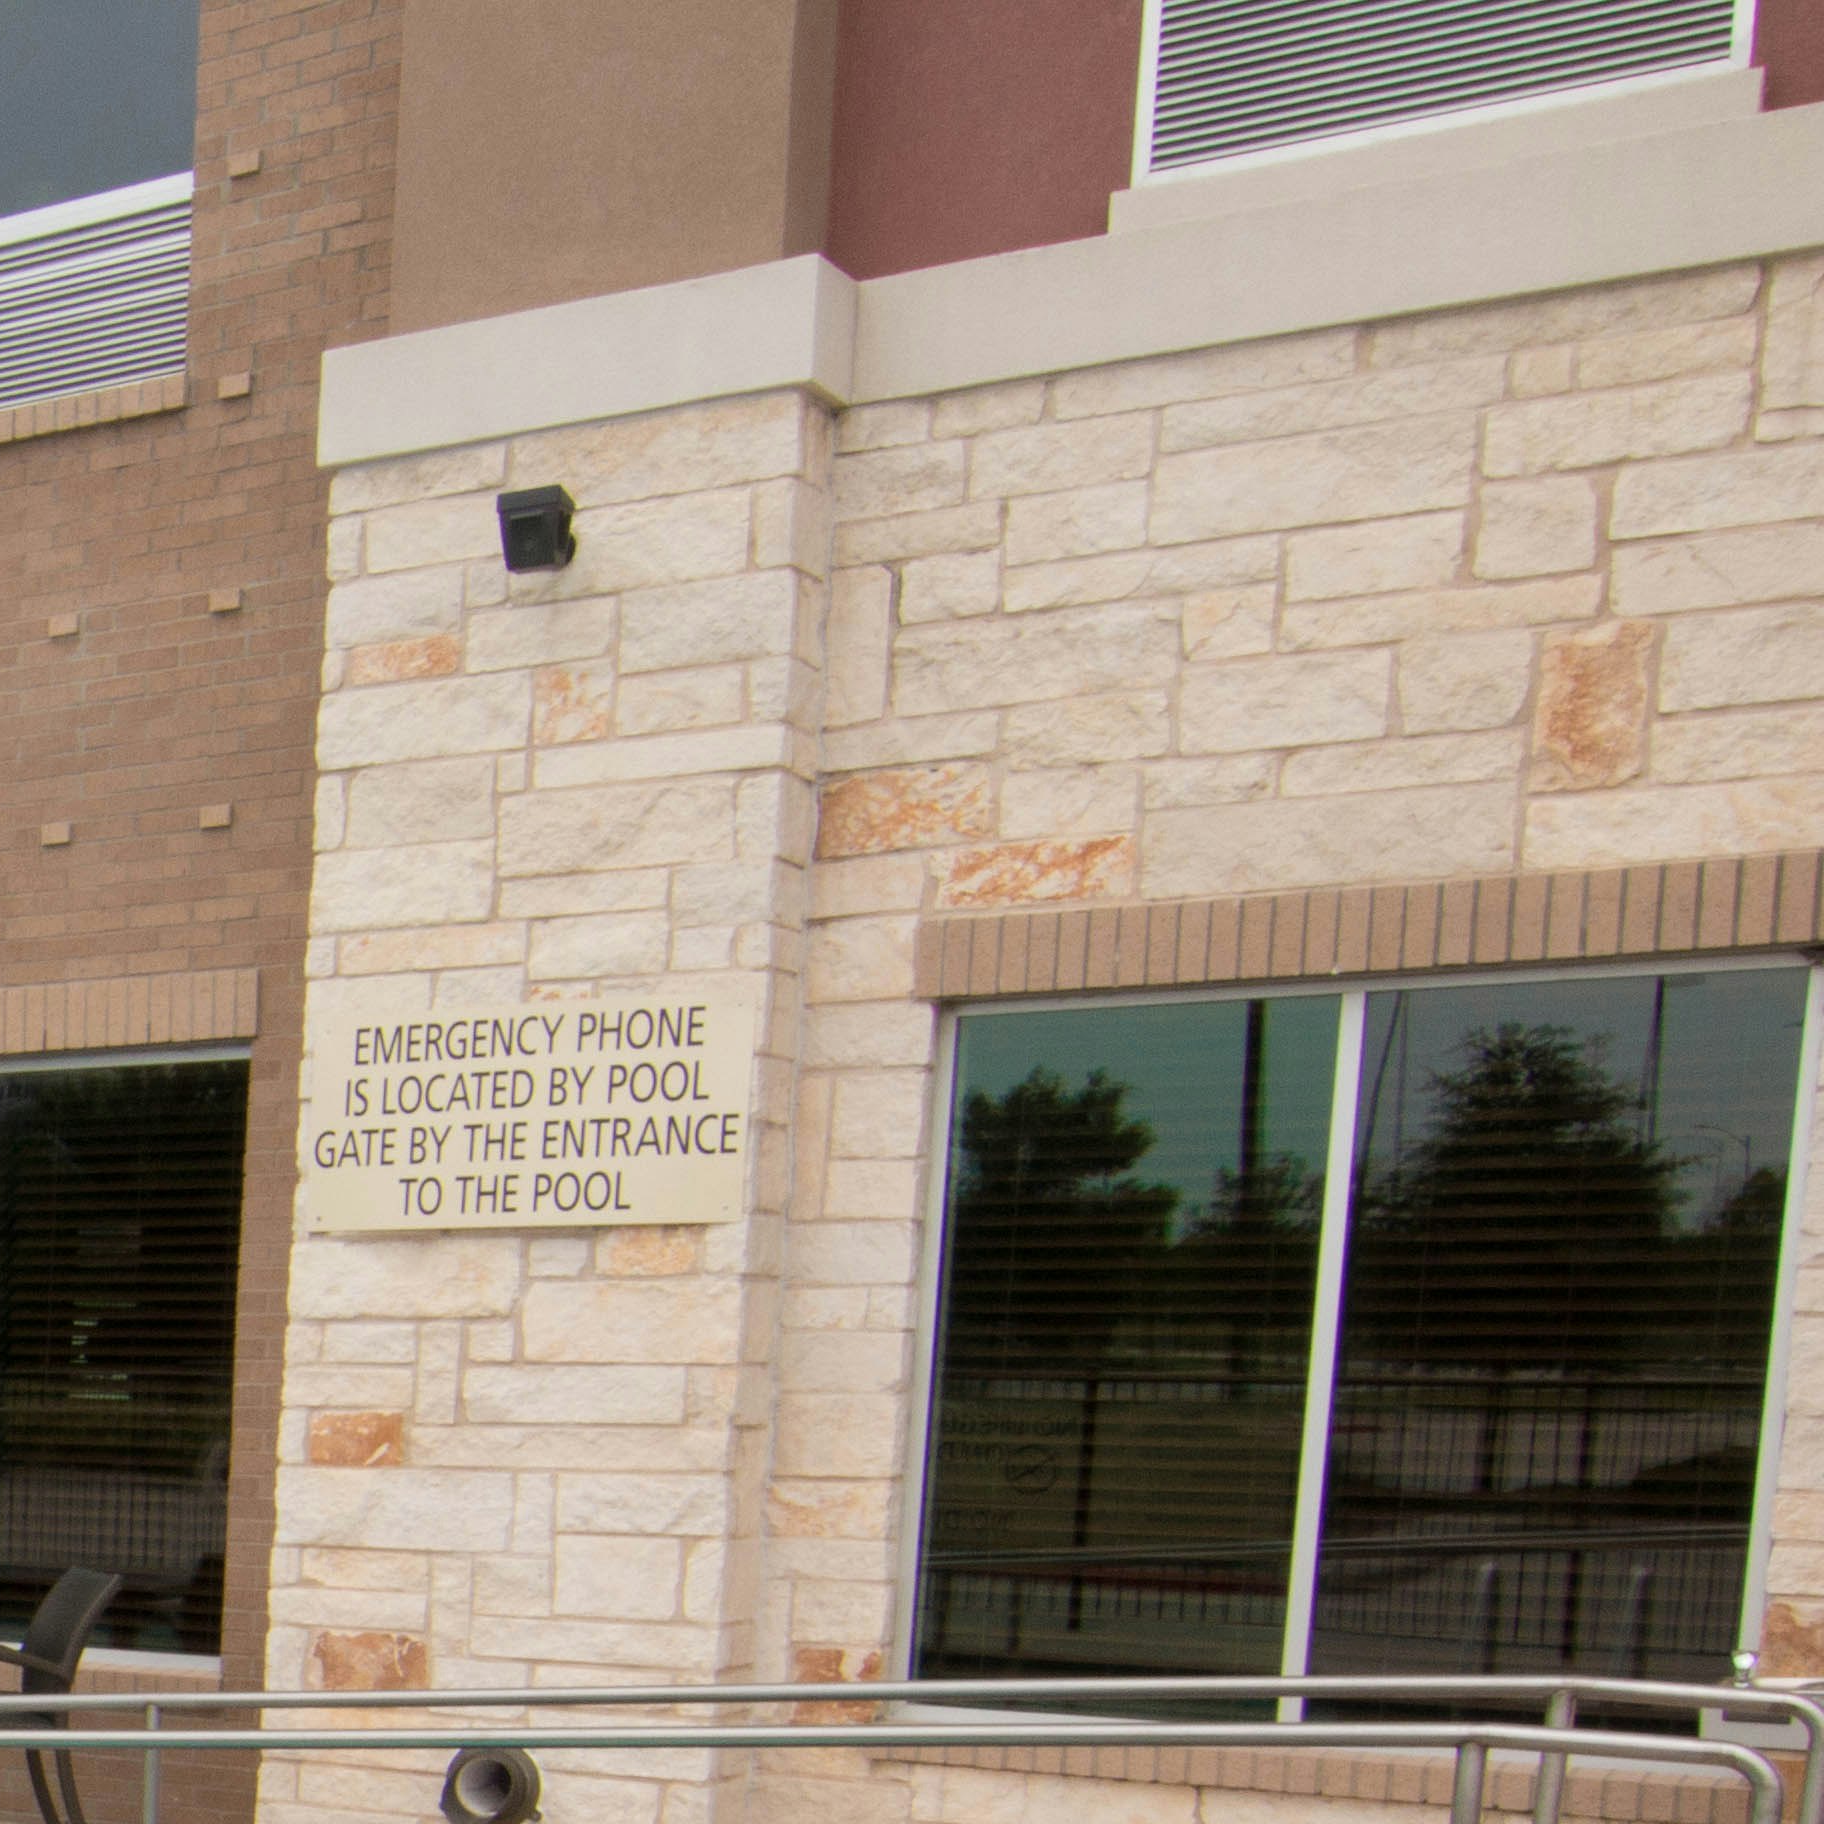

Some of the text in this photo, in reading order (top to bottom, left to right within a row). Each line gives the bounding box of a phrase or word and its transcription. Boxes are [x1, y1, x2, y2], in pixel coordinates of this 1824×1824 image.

[354, 1006, 707, 1065] EMERGENCY PHONE
[344, 1061, 710, 1117] IS LOCATED BY POOL
[314, 1113, 740, 1169] GATE BY THE ENTRANCE
[400, 1171, 631, 1216] TO THE POOL
